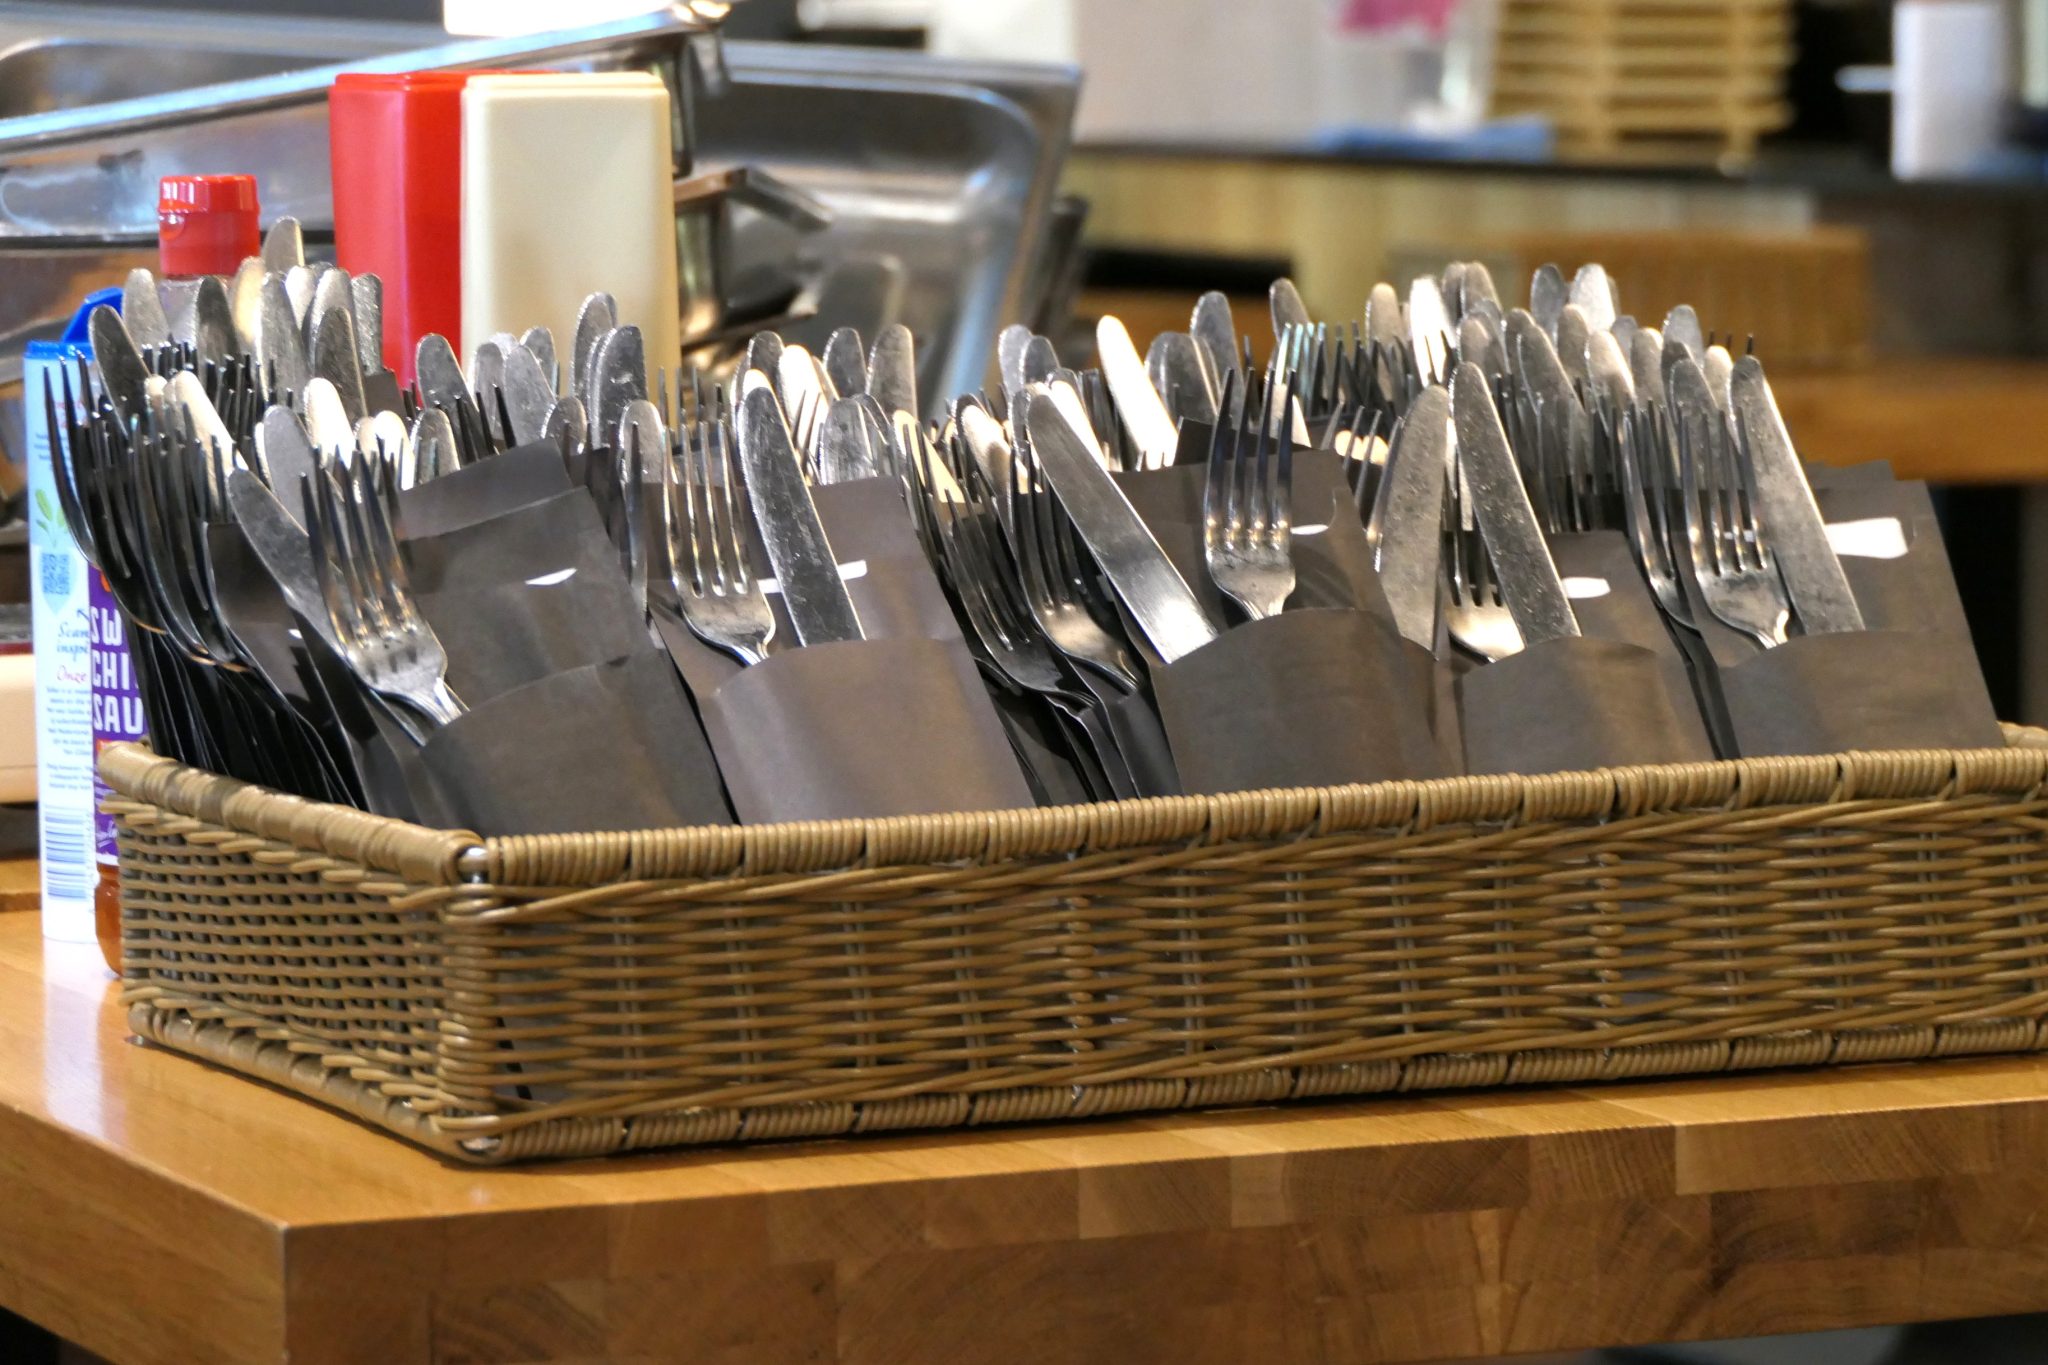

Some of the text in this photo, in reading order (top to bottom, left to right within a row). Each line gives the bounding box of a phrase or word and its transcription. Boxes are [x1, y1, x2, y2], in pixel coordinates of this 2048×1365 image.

[57, 621, 89, 638] Scan
[92, 649, 139, 690] CHI
[93, 693, 144, 734] SAU
